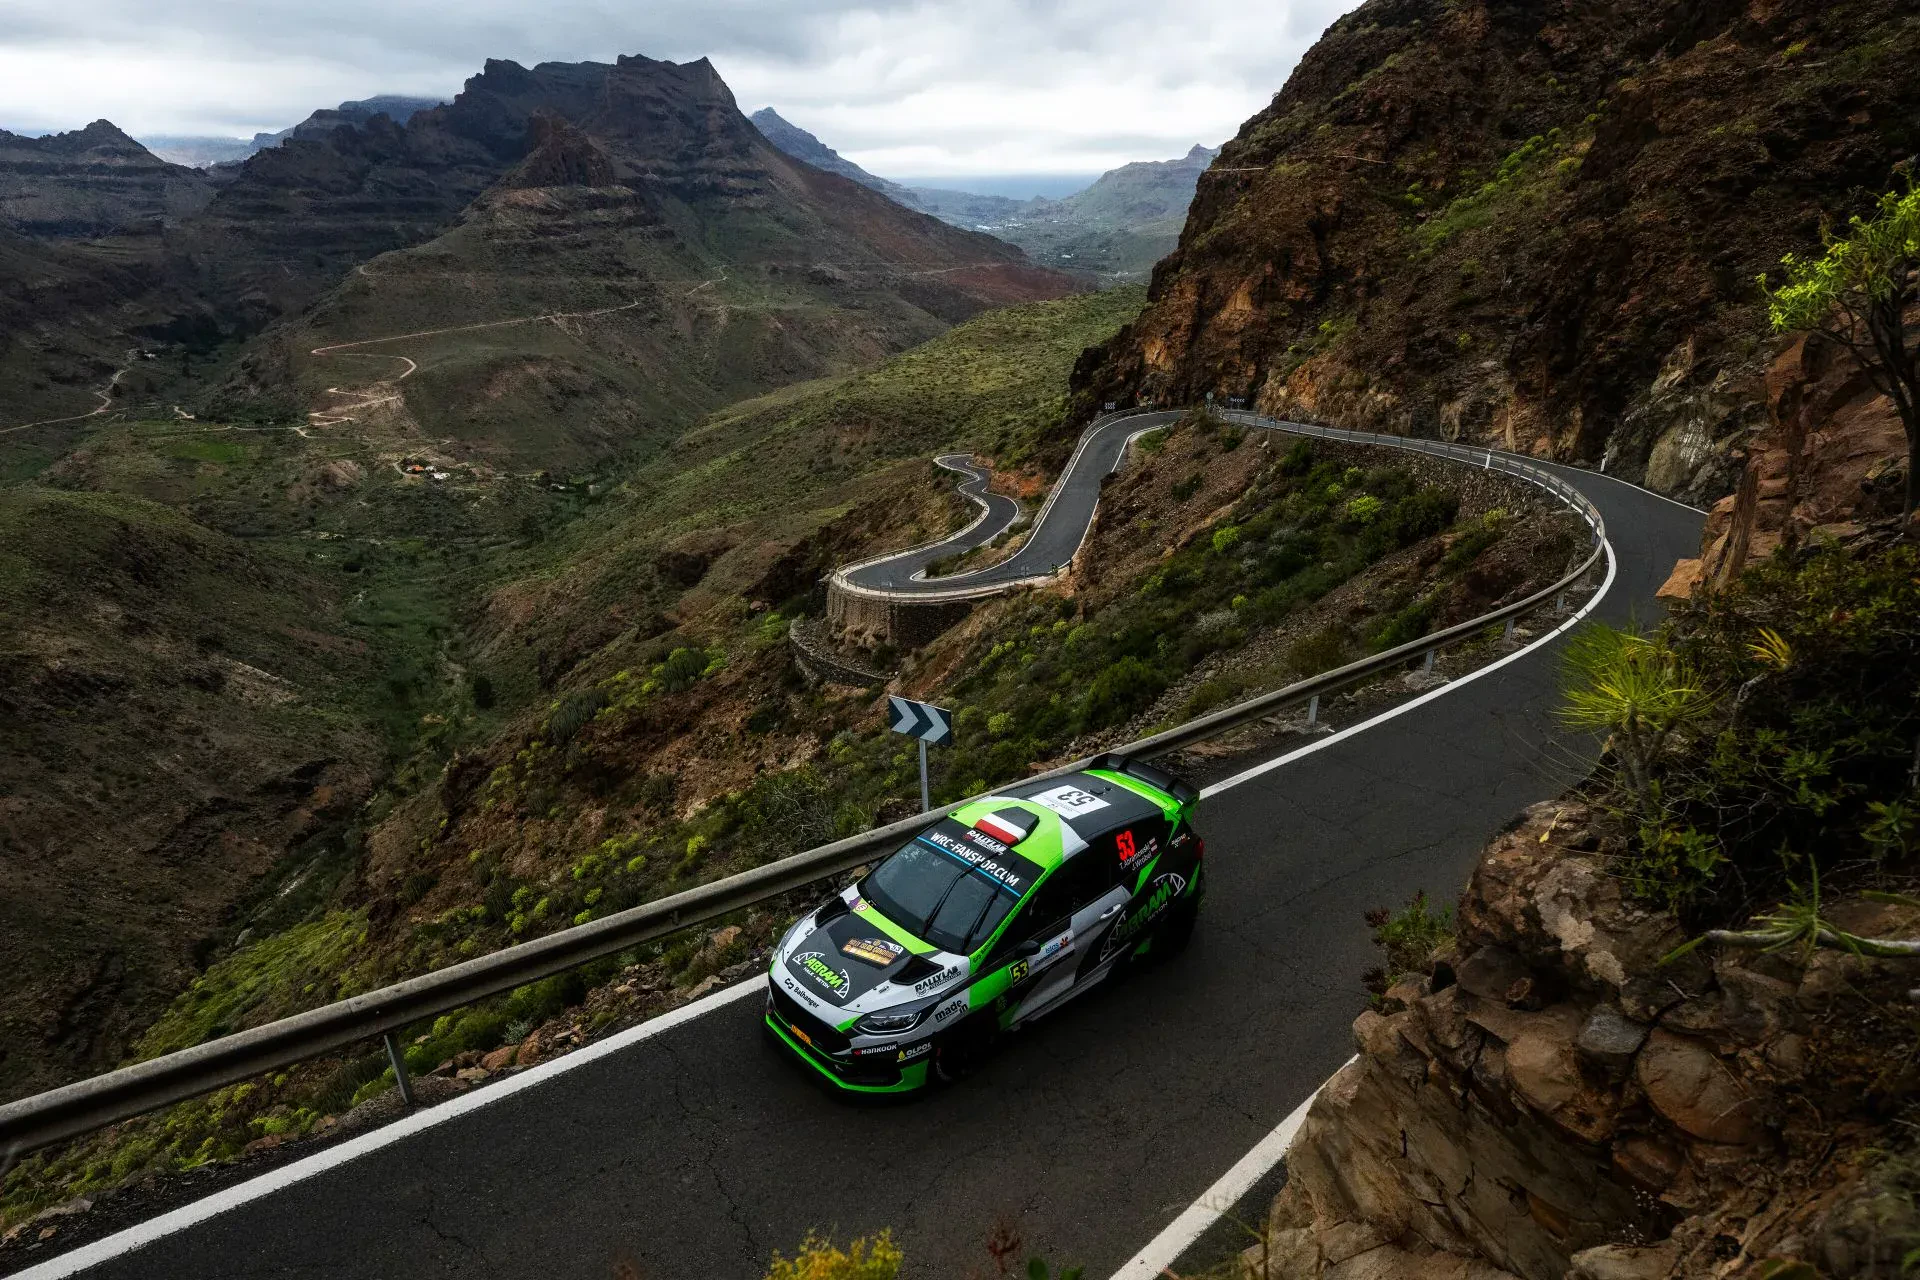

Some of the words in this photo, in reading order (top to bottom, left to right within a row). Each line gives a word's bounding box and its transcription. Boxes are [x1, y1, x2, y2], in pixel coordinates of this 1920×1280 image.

[1057, 790, 1095, 806] 53
[1116, 830, 1135, 861] 53
[930, 832, 1019, 887] WRC-FANSHOP.COM
[1117, 882, 1172, 942] ABRAM
[803, 957, 845, 988] ABRAM
[915, 966, 958, 992] RALLYLAB
[1012, 961, 1028, 983] 53
[935, 1000, 963, 1021] made
[959, 1003, 969, 1014] in
